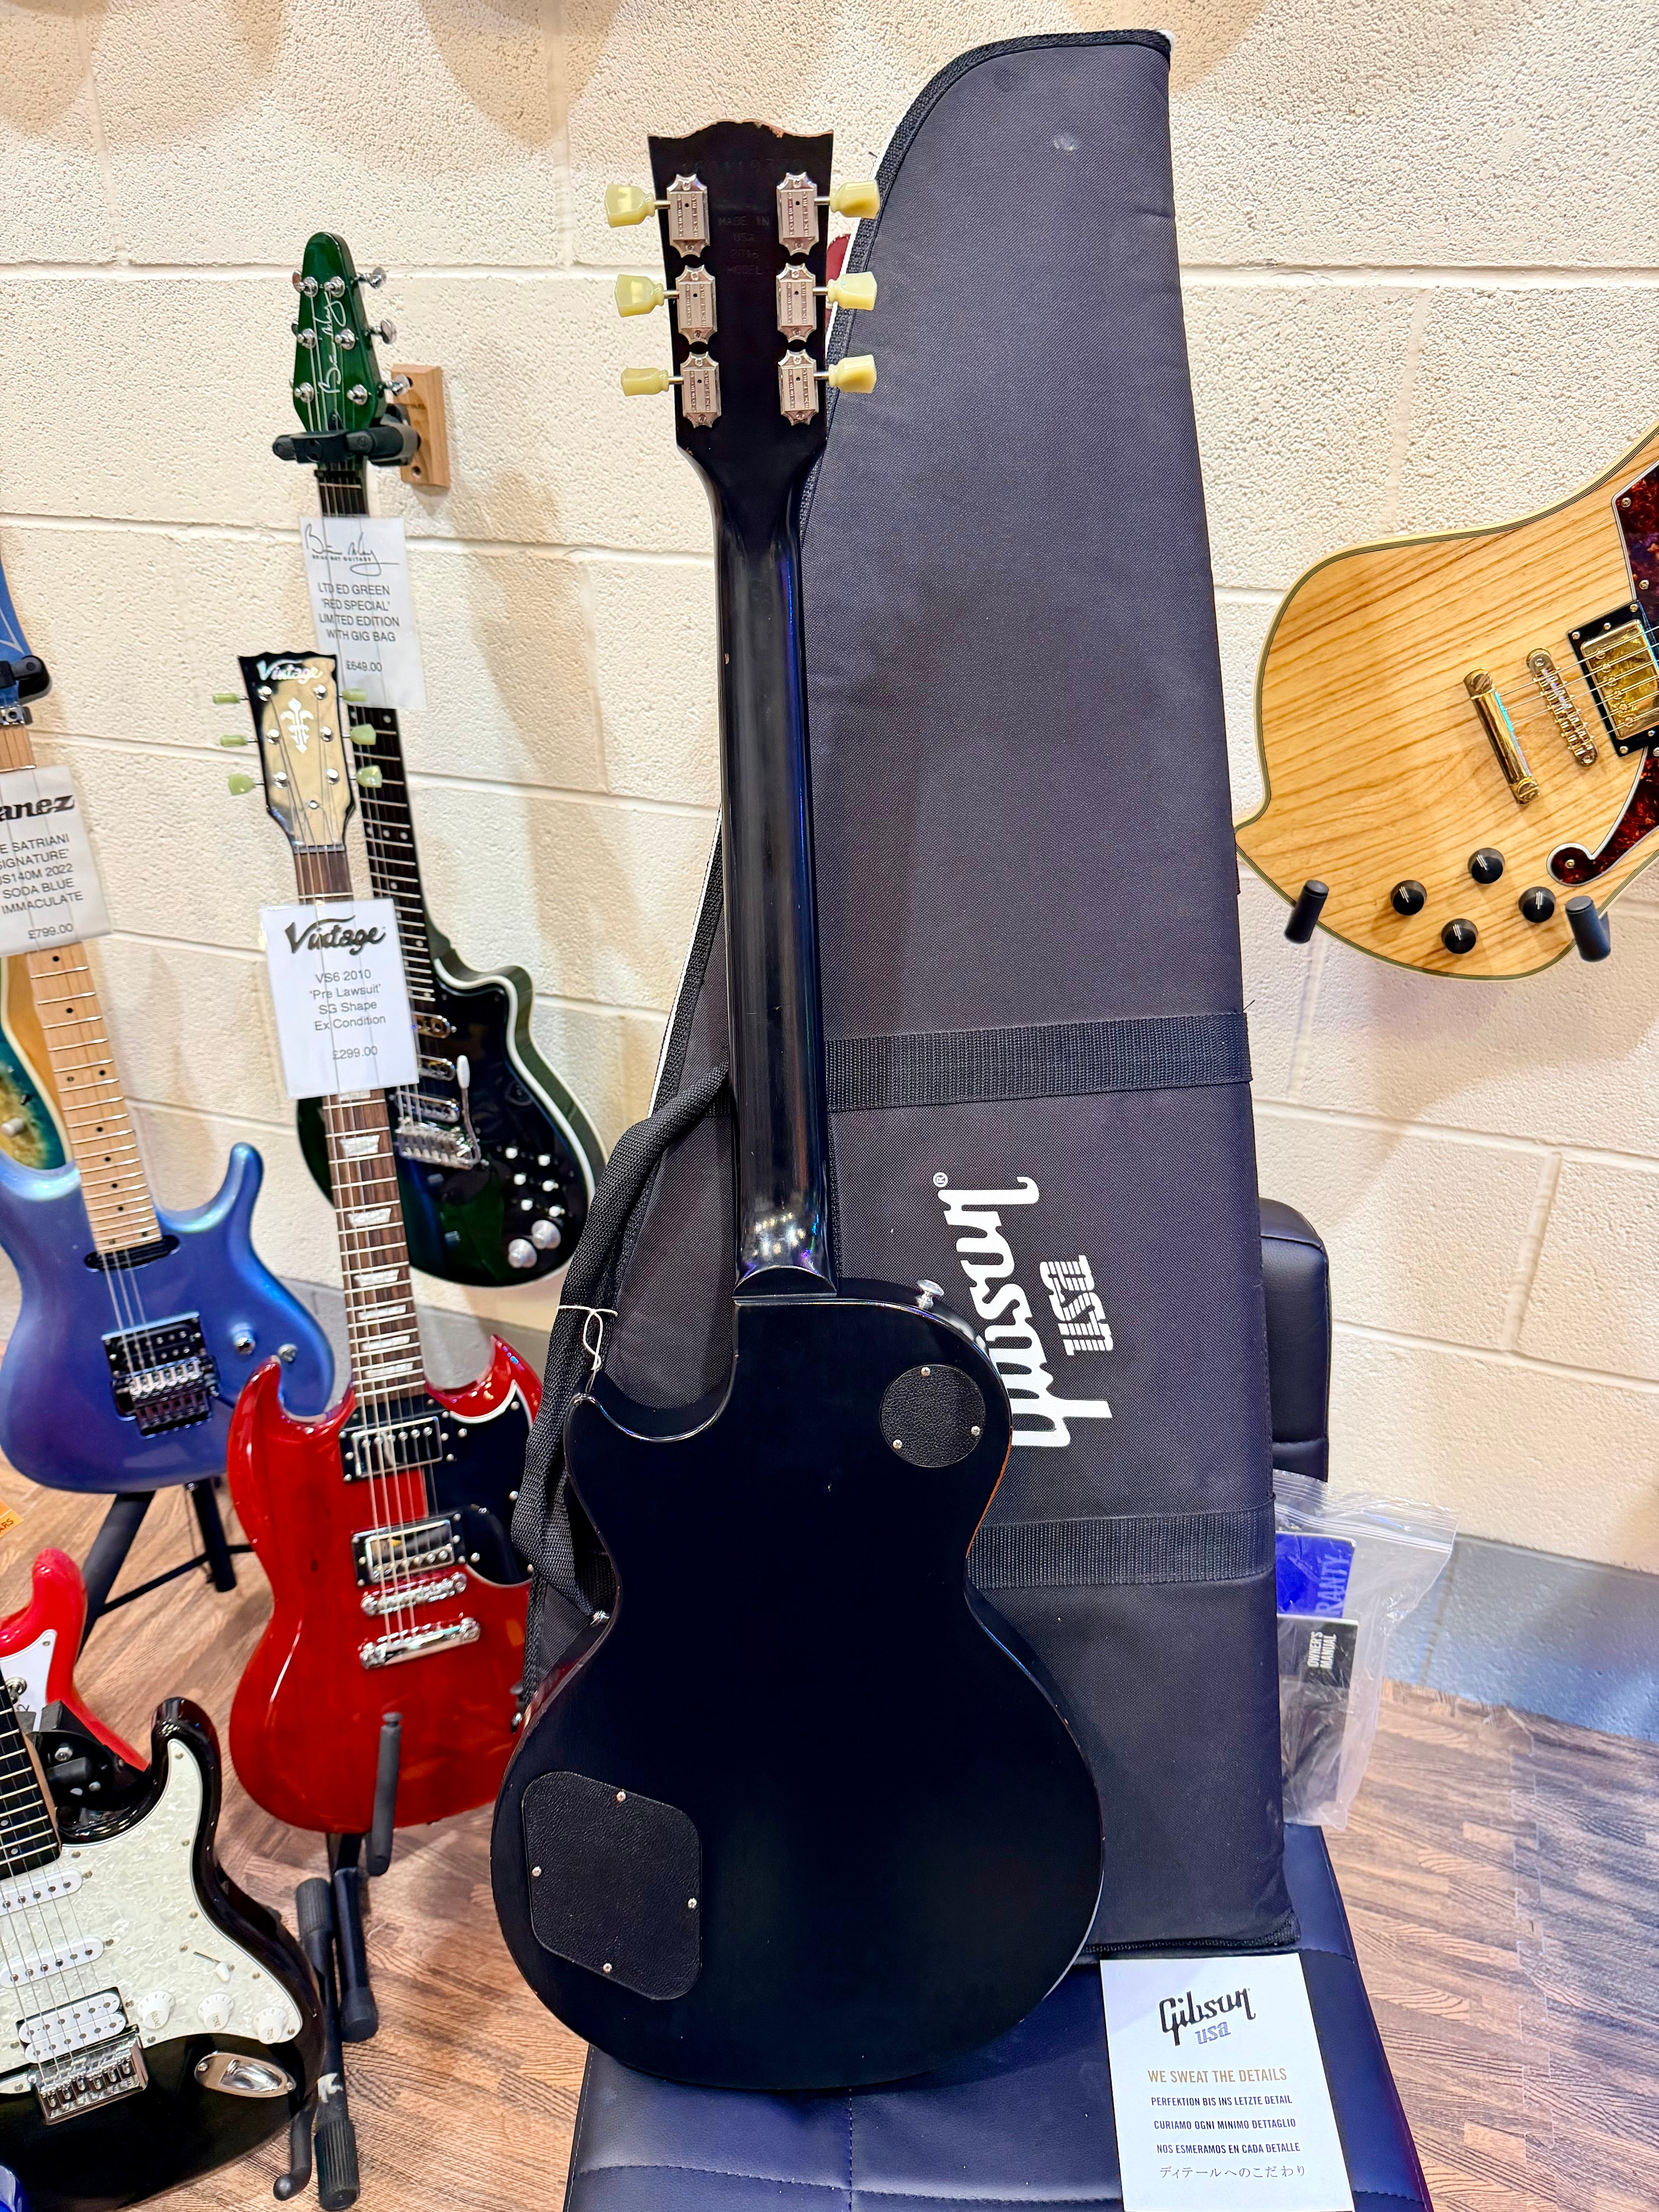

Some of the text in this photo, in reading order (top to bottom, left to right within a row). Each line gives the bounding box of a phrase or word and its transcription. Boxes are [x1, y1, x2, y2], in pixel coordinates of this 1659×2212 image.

[318, 582, 390, 596] LTD ED GREEN
[319, 613, 400, 627] LIMITED EDITION
[326, 629, 396, 642] WITH GIG BAG
[256, 659, 323, 684] Vintage
[12, 833, 70, 852] SATRIANI
[45, 863, 74, 877] 2022
[3, 878, 75, 899] SODA BLUE
[2, 891, 84, 914] IMMACULATE
[285, 915, 386, 955] Vintage
[315, 969, 371, 984] VS6 2010
[319, 1001, 378, 1015] SG Shape
[314, 1015, 386, 1031] Ex Condition
[333, 1046, 378, 1060] £299.00
[1320, 1634, 1337, 1669] MANUAL
[1159, 1987, 1256, 2046] Gibson
[1147, 2068, 1287, 2083] WE SWEAT THE DETAILS
[1151, 2095, 1293, 2106] PERFEKTION BIS INS LETZTE DETAIL
[1154, 2118, 1296, 2130] CURIAMO OGNI MINIMO DETTAGLIO
[1157, 2142, 1300, 2154] NOS ESMERAMOS EN CADA DETALLE
[1159, 2165, 1305, 2179] ディテールへのこだわり
